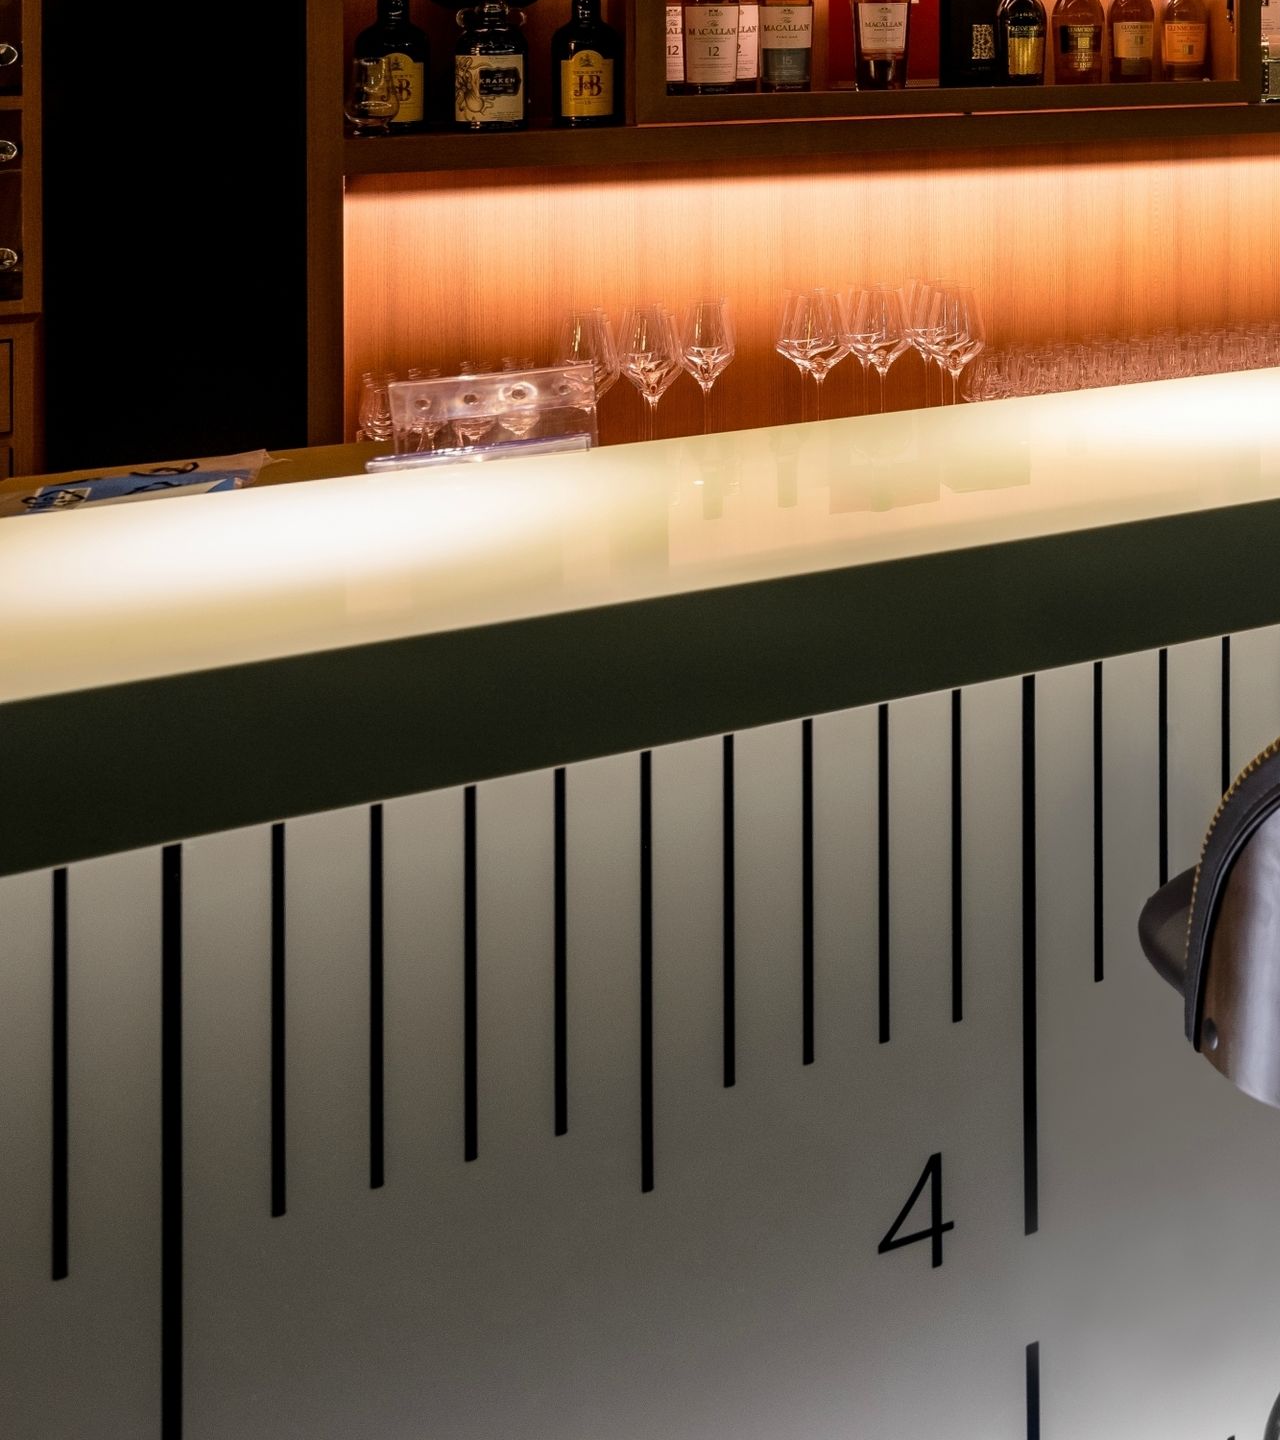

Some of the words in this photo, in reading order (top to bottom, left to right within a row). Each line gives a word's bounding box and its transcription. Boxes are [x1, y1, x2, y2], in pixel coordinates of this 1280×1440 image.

[763, 24, 810, 32] MACALLAN
[668, 45, 680, 56] 12
[708, 46, 720, 57] 12
[574, 75, 602, 97] J&B
[878, 1152, 955, 1268] 4
